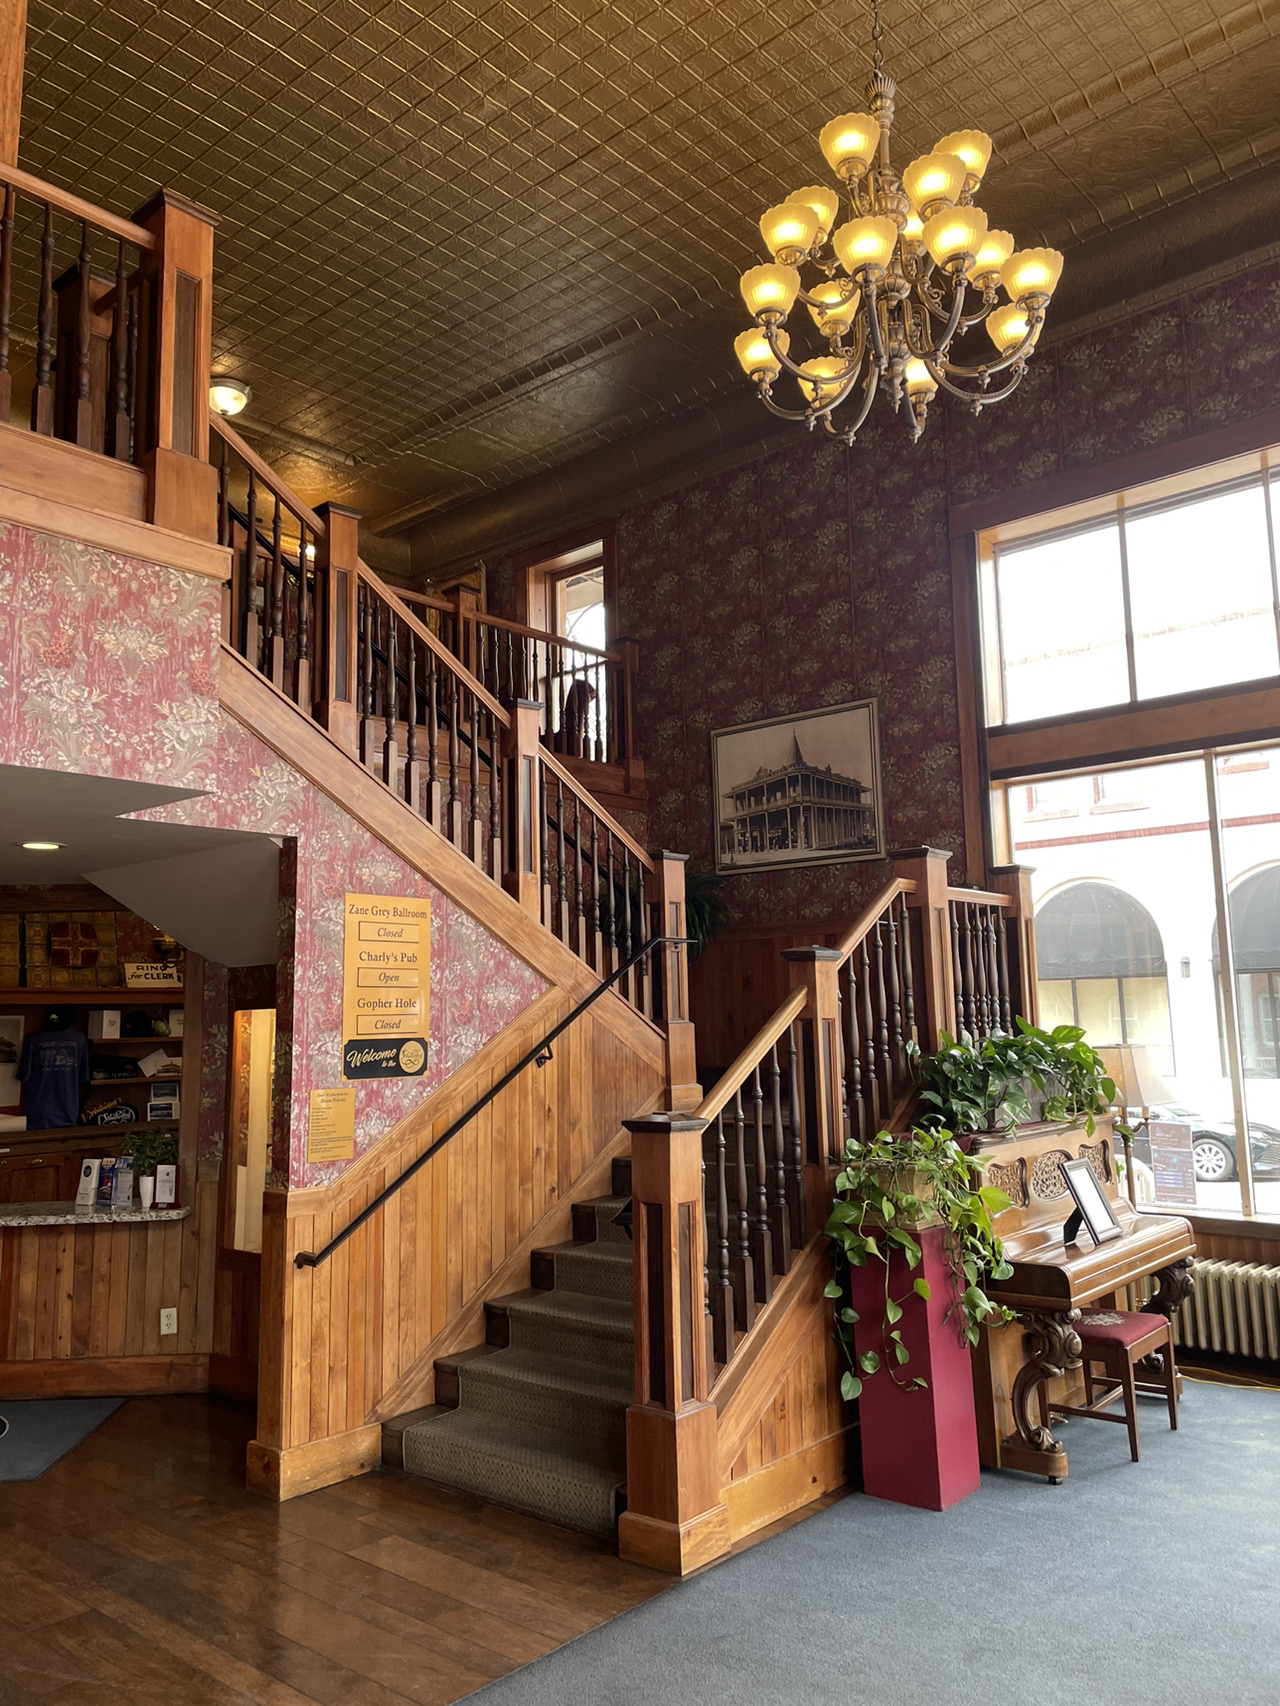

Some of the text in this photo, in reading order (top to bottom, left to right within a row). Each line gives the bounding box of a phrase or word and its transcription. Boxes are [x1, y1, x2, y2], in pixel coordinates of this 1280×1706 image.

[349, 904, 427, 919] Zane Grey Ballroom
[377, 927, 403, 937] Closed
[359, 951, 417, 964] Charly's Pub
[128, 971, 174, 980] for CLERK
[378, 972, 400, 984] Open
[357, 997, 416, 1010] Gopher Hole
[374, 1019, 401, 1029] Closed
[346, 1048, 397, 1068] Welcome
